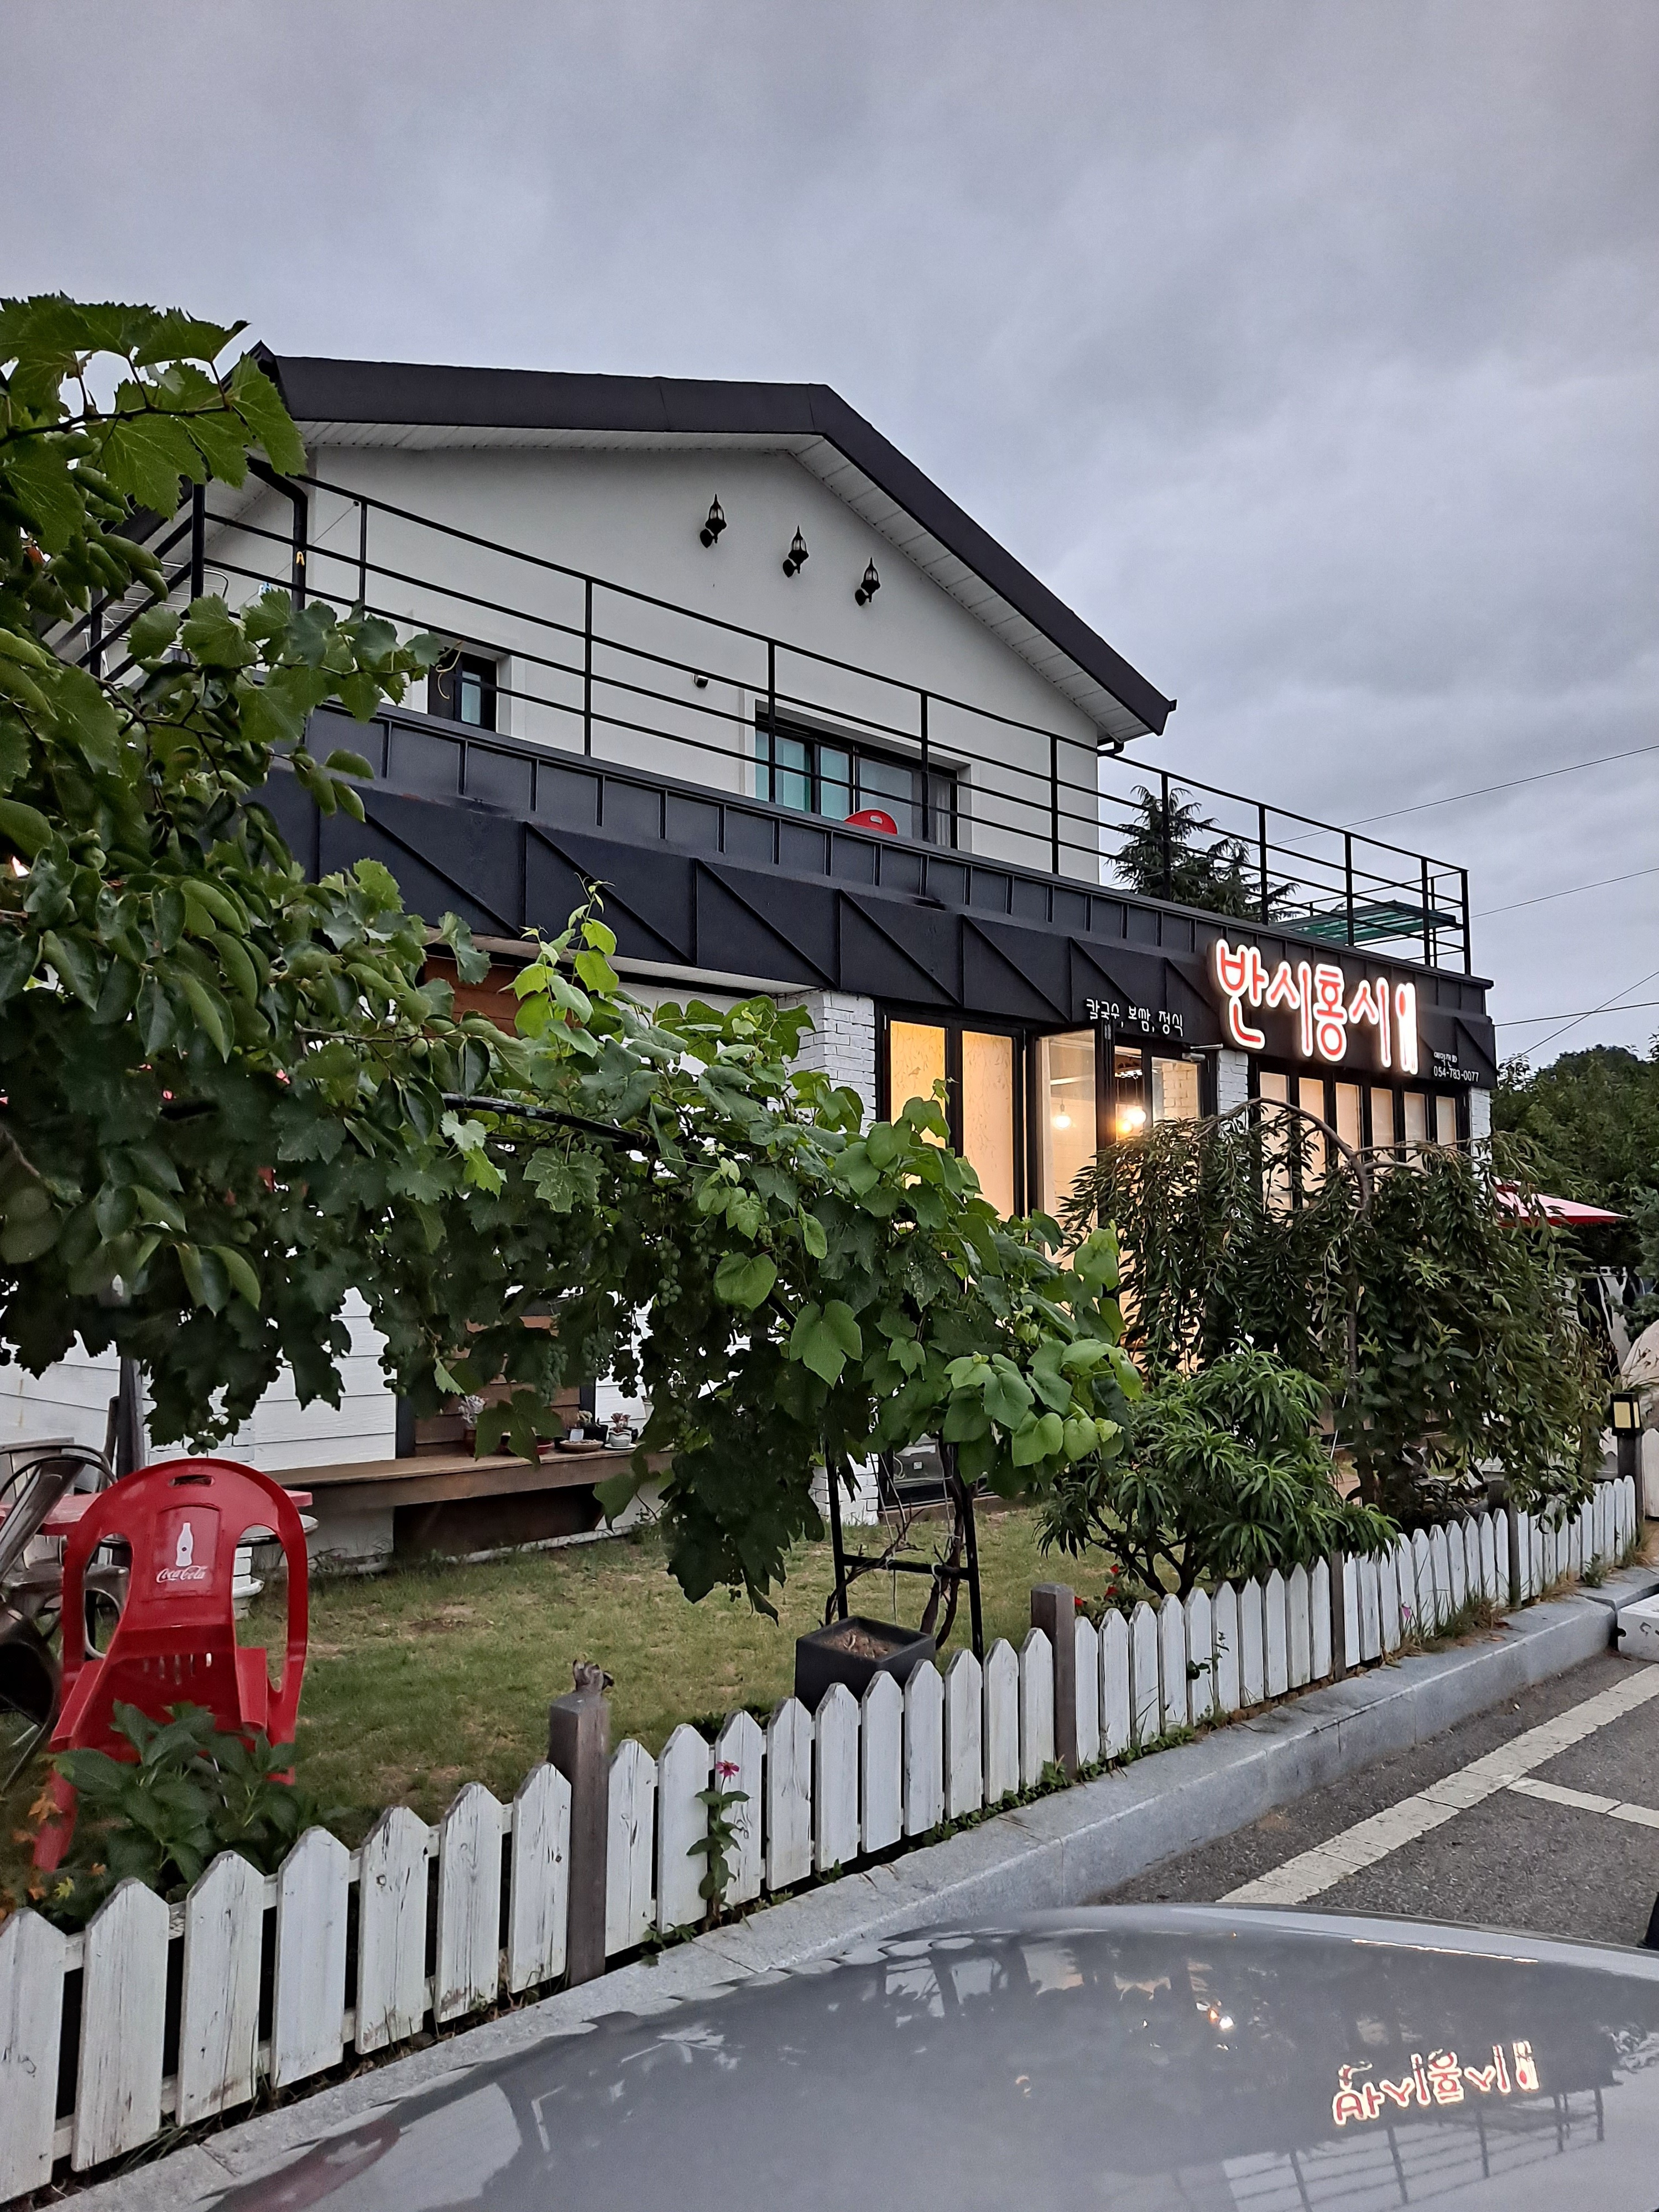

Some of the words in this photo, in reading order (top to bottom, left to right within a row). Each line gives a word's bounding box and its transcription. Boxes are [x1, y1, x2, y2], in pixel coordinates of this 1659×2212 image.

[1086, 998, 1124, 1029] 칼국수,
[1128, 1005, 1155, 1033] 보쌈,
[1159, 1010, 1183, 1037] 정식
[1216, 939, 1391, 1068] 반시홍시
[1433, 1065, 1479, 1082] 054-783-0077
